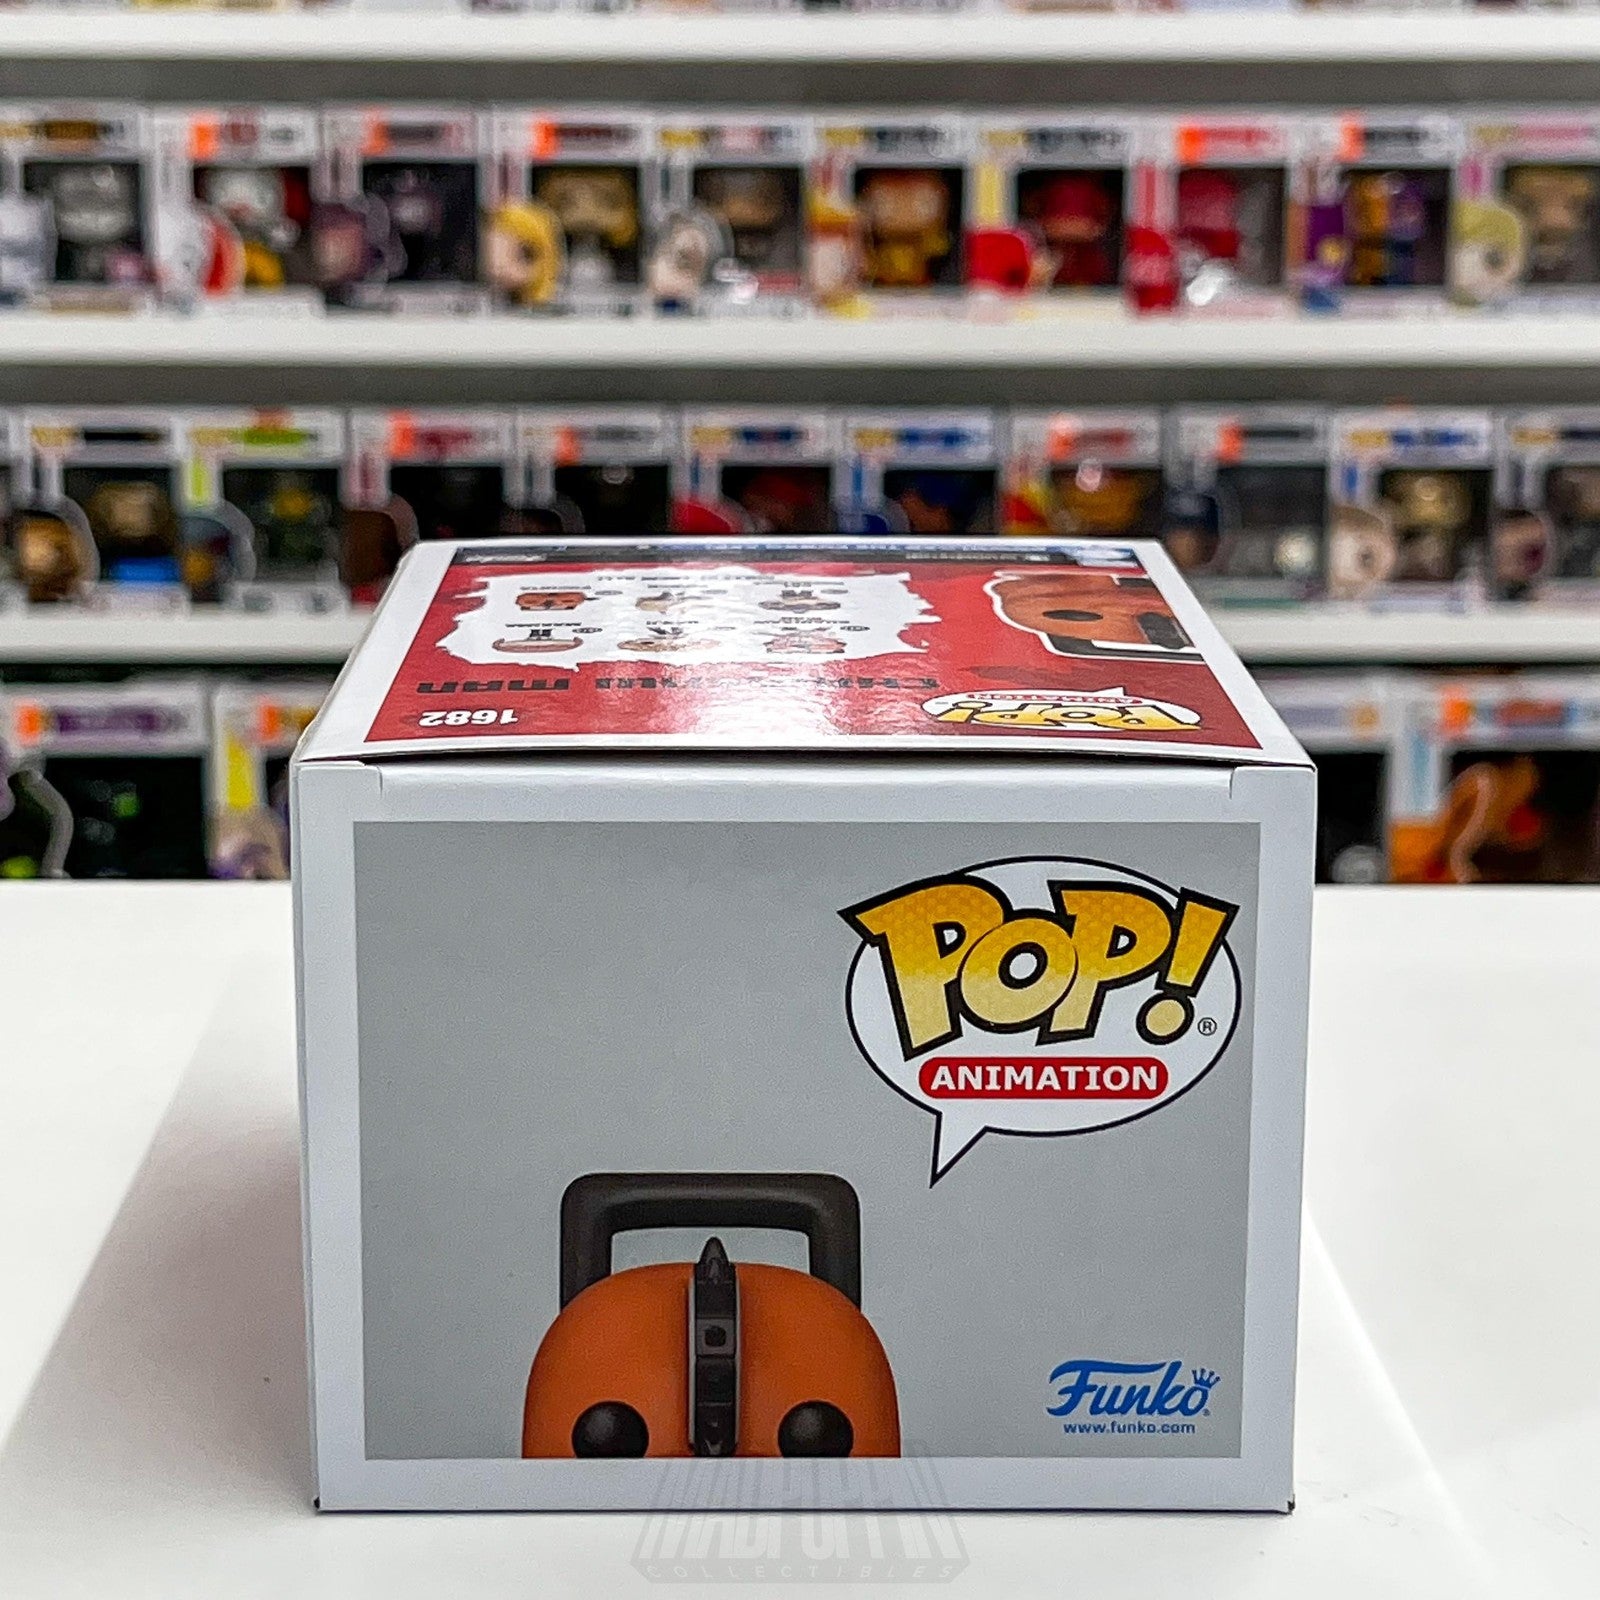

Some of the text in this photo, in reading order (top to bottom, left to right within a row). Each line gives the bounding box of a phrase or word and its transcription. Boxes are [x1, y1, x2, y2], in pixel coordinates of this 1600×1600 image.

[973, 694, 1136, 704] ANIMATION
[418, 708, 519, 726] 1682
[935, 701, 1201, 730] POP!
[838, 873, 1241, 1062] POP!
[930, 1065, 1159, 1092] ANIMATION
[1046, 1359, 1208, 1417] Funko
[1062, 1421, 1196, 1434] www.funko.com
